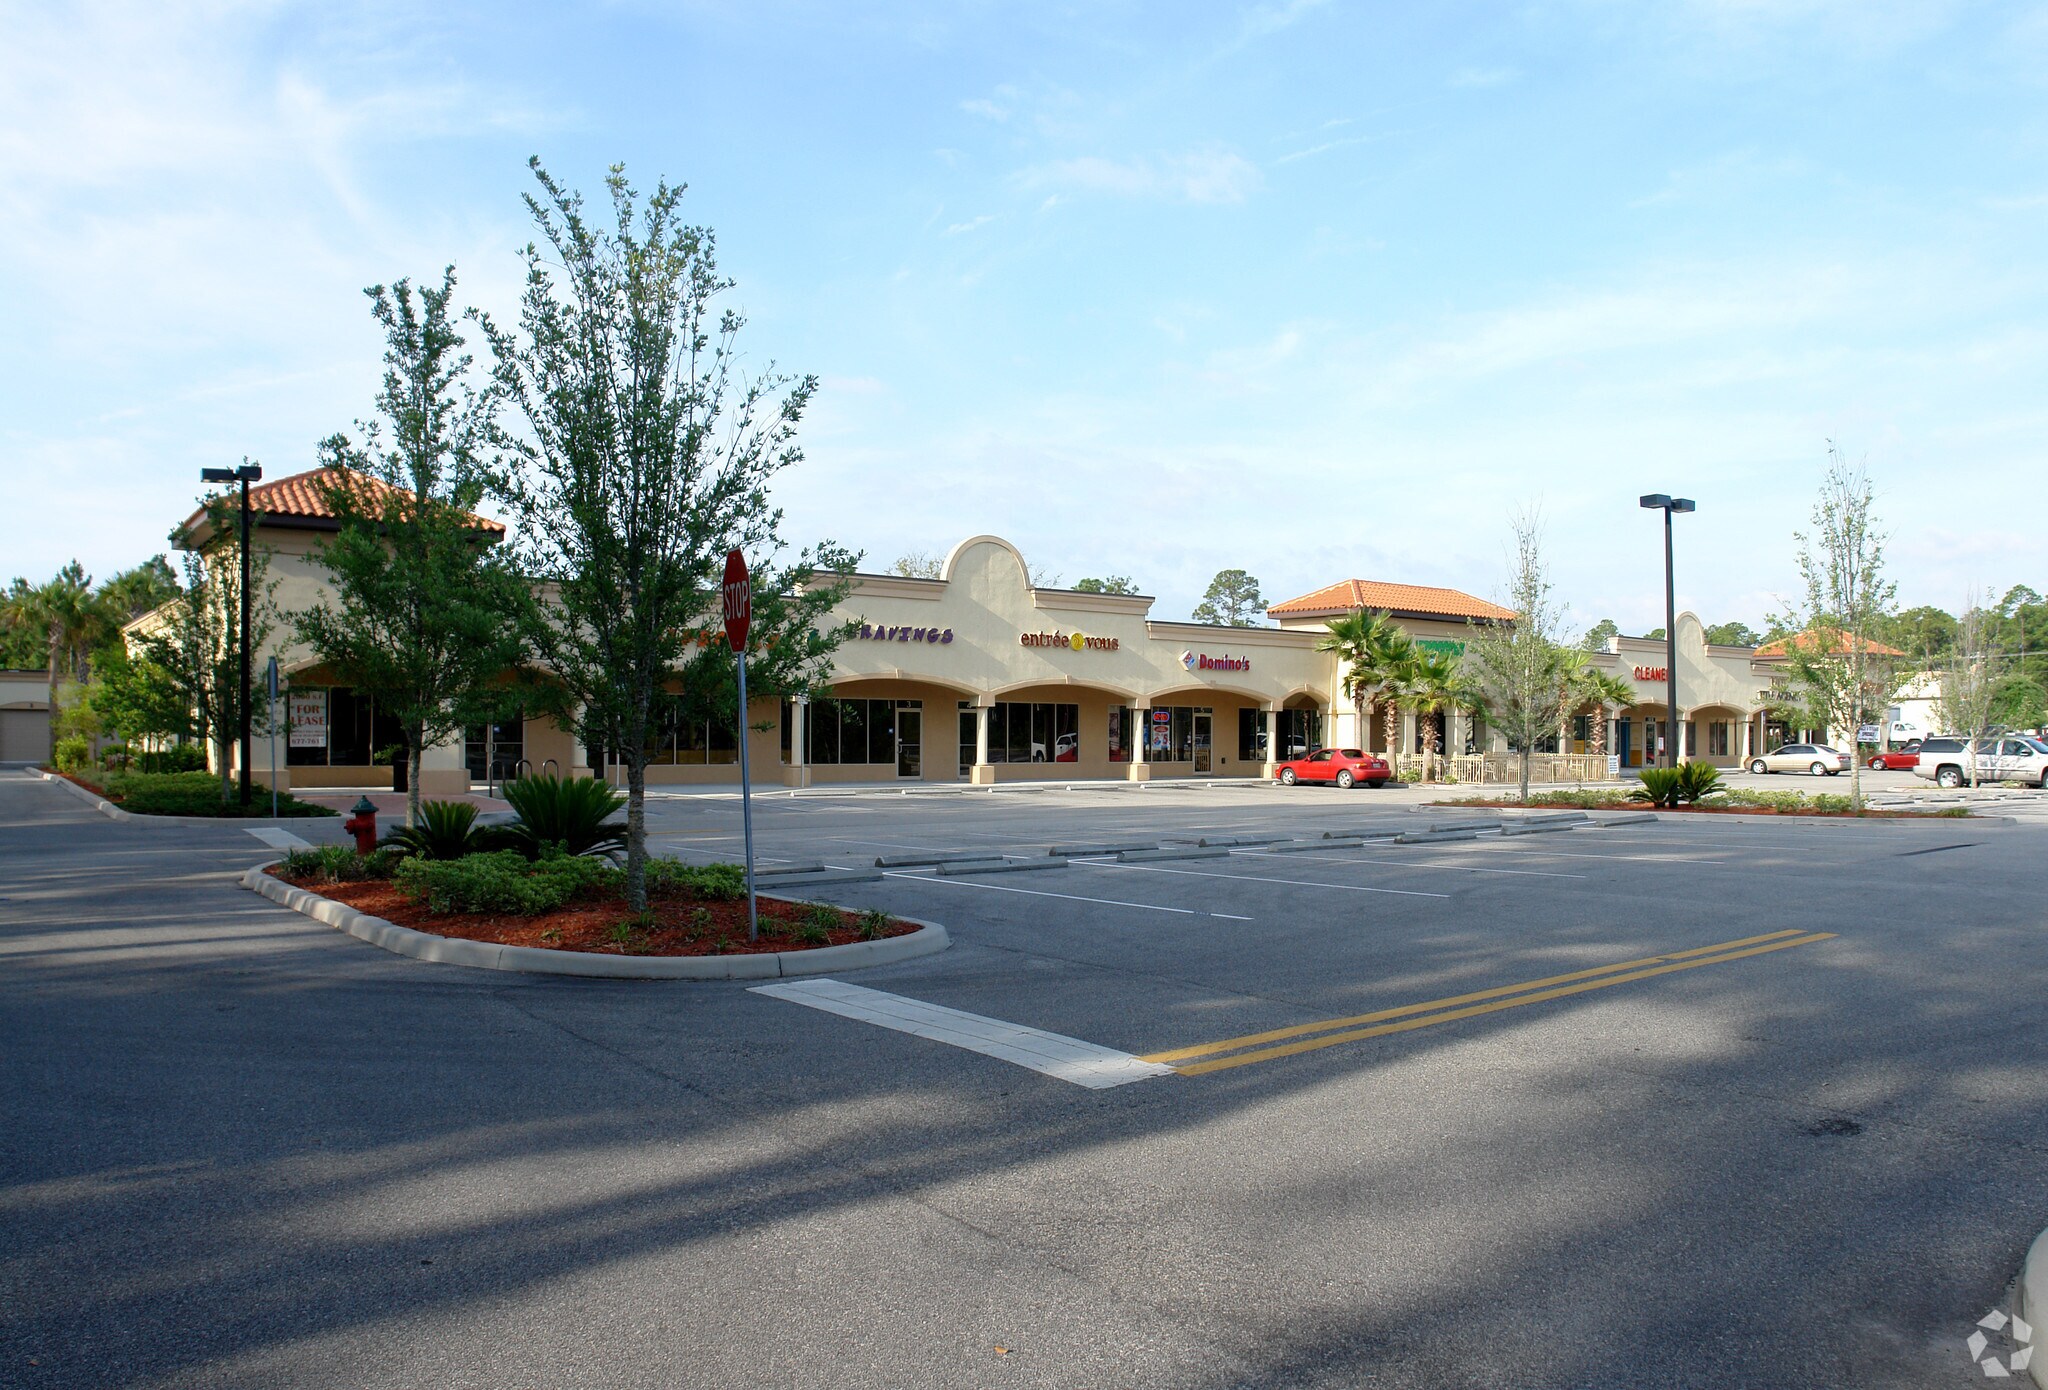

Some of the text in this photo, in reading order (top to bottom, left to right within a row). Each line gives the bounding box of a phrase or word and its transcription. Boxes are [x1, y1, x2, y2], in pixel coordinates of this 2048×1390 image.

[724, 580, 748, 621] STOP
[849, 624, 954, 644] RAVINGS
[1020, 630, 1120, 651] entrée vous
[1198, 653, 1250, 671] Domino's
[297, 705, 320, 714] FOR
[290, 716, 325, 726] LEASE
